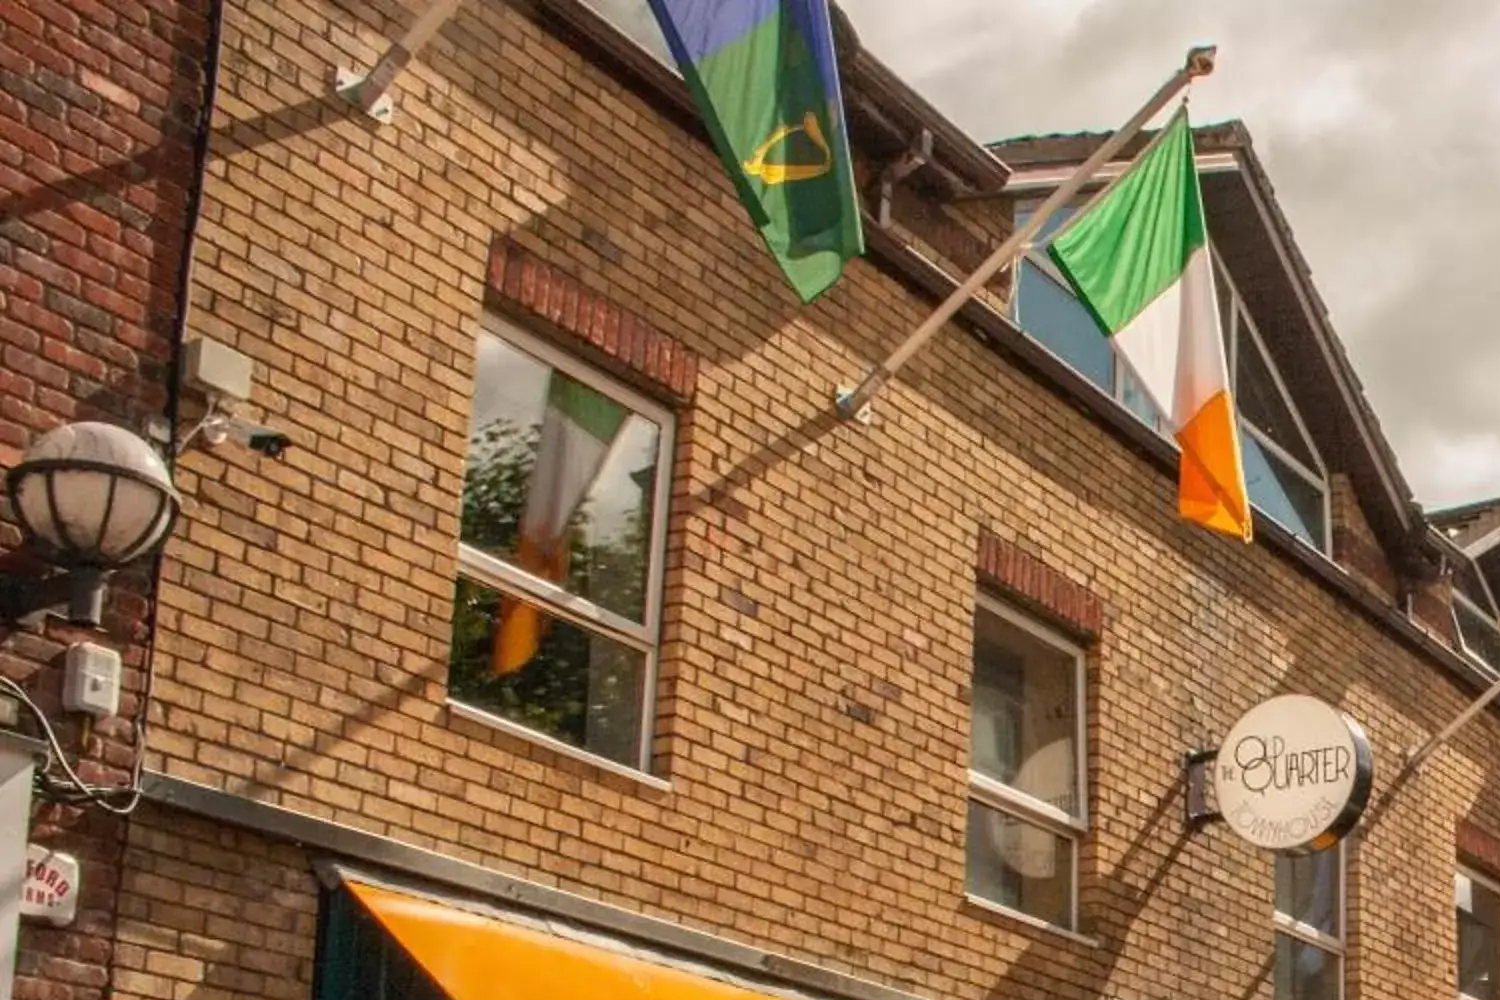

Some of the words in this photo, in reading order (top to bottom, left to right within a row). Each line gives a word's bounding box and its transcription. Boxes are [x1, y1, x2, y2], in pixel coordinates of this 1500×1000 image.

[1235, 736, 1284, 770] OLD
[1222, 765, 1235, 781] THE
[1242, 746, 1350, 796] QUARTER
